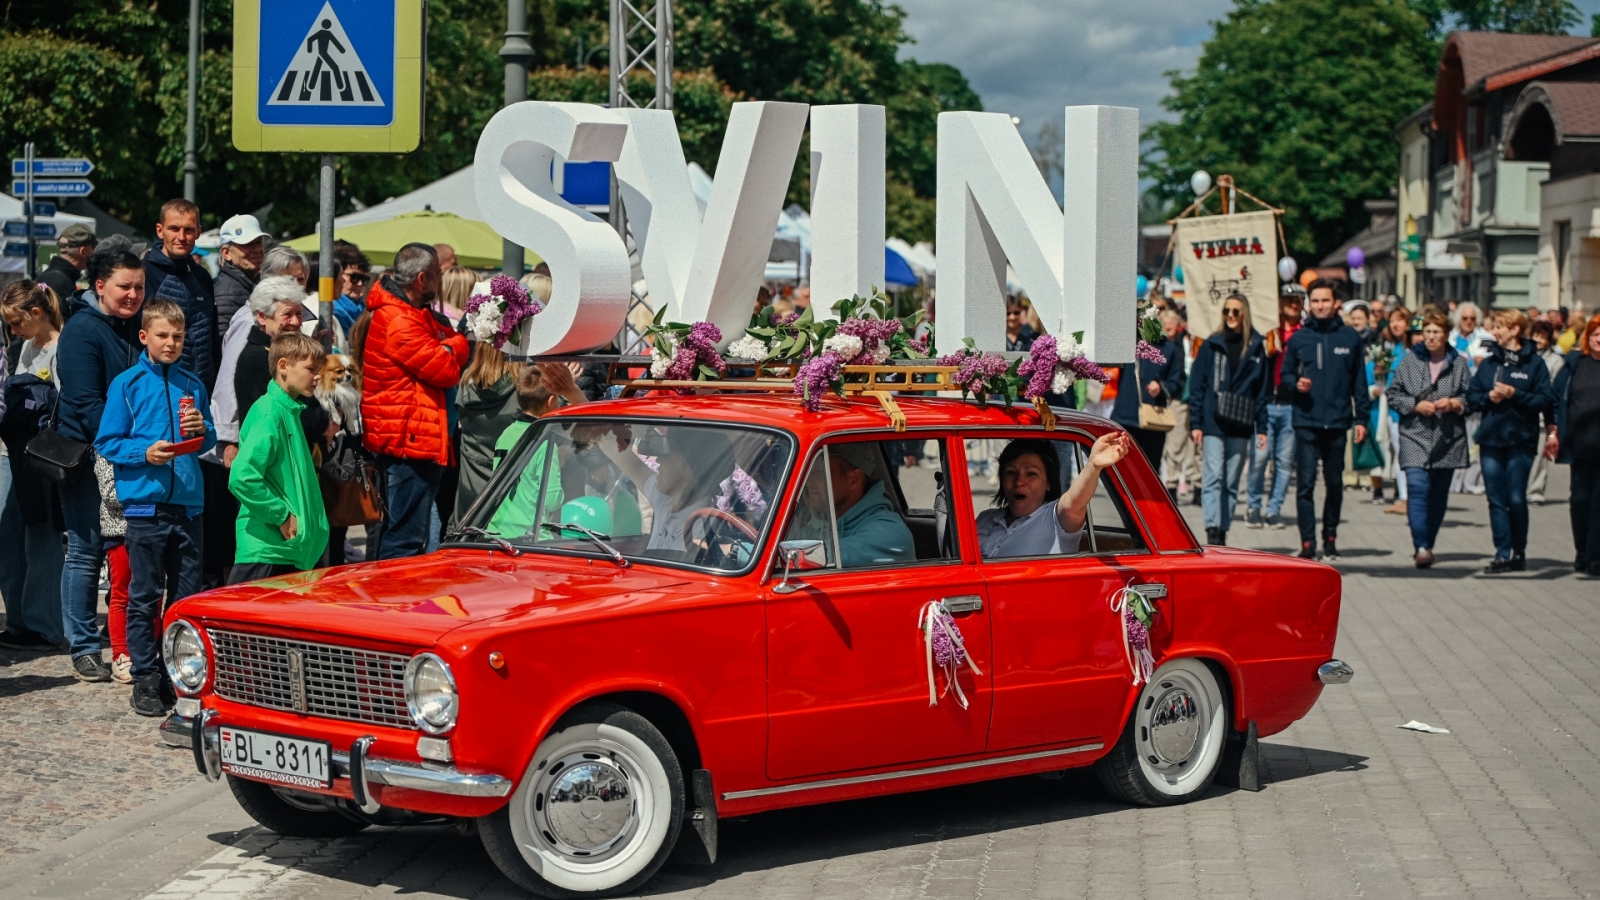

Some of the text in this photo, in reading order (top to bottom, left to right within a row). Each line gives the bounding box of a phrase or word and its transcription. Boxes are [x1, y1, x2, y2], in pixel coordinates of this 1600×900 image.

[473, 100, 1139, 364] SVIN
[222, 748, 232, 759] LV
[235, 733, 323, 776] BL-8311
